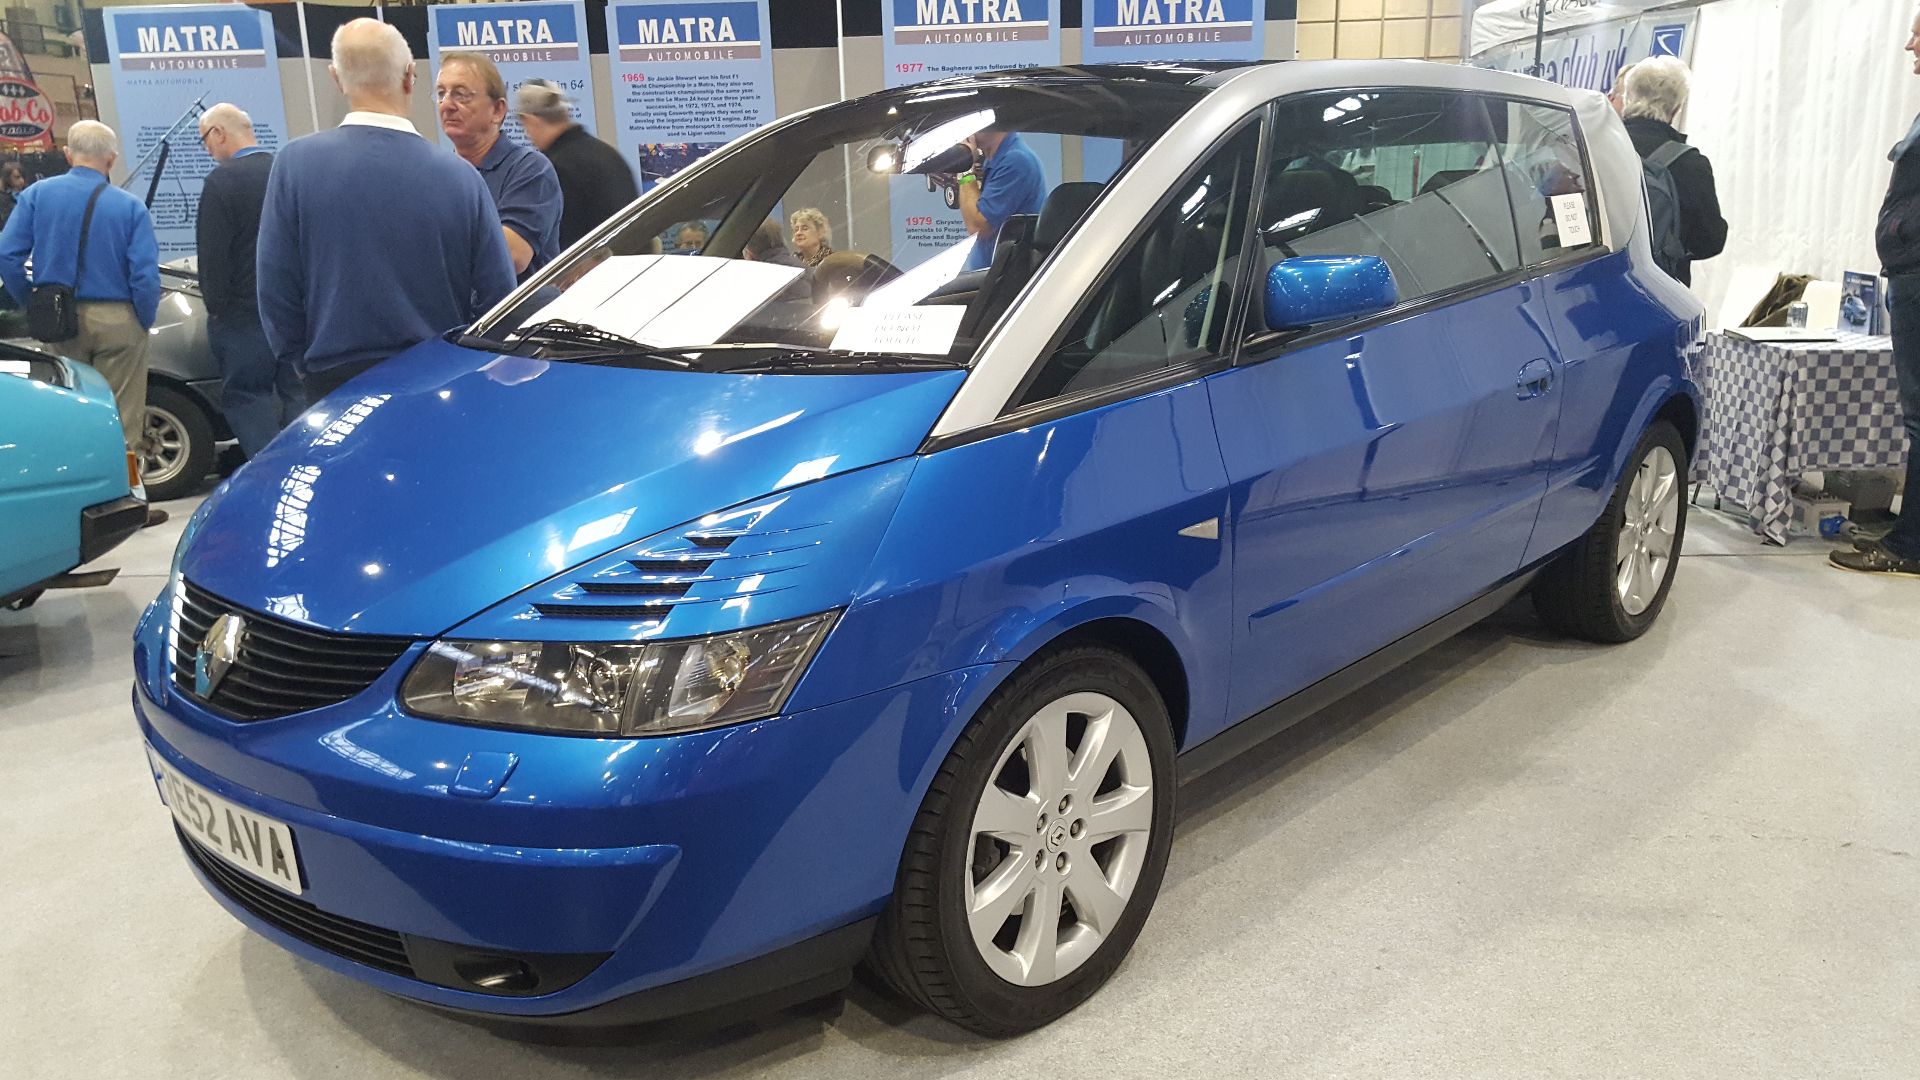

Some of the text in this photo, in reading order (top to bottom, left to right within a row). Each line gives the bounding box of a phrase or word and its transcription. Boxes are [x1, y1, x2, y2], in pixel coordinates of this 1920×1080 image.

[916, 0, 1022, 25] MATRA
[1117, 0, 1225, 25] MATRA
[457, 19, 553, 46] MATRA
[638, 17, 736, 44] MATRA
[137, 25, 239, 52] MATRA
[924, 32, 1018, 44] AUTOMOBILE
[1124, 32, 1220, 45] AUTOMOBILE
[488, 52, 552, 62] OMOBILE
[648, 50, 733, 61] AUTOMOBILE
[150, 59, 238, 70] AUTOMOBILE
[896, 64, 923, 72] 1977
[622, 73, 645, 82] 1969
[570, 79, 584, 90] 64
[906, 217, 932, 225] 1979
[225, 808, 291, 882] AVA
